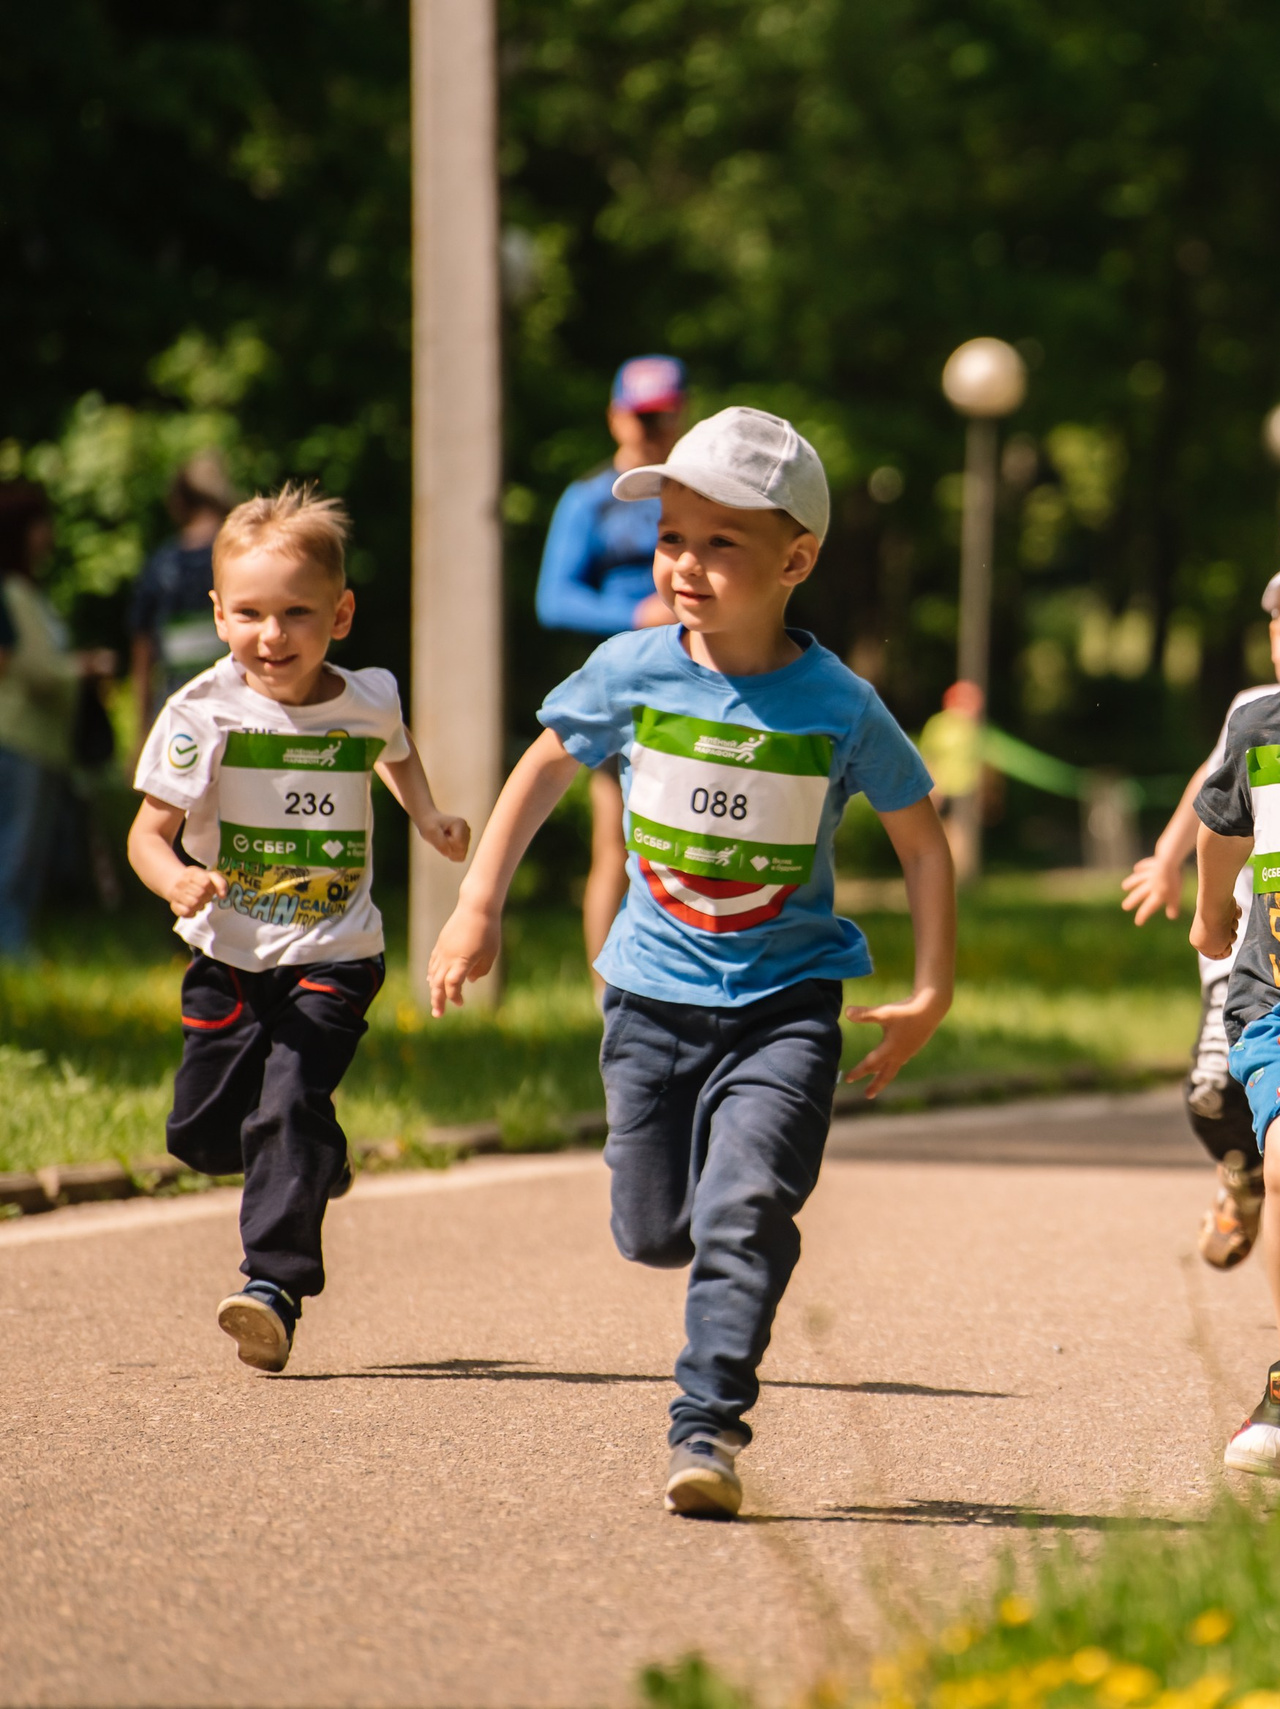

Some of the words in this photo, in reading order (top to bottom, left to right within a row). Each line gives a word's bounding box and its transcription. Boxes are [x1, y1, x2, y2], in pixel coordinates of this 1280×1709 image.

[284, 792, 335, 816] 236
[691, 787, 747, 820] 088
[252, 839, 297, 854] СБЕР
[643, 835, 672, 851] СБЕР
[238, 870, 261, 889] THE
